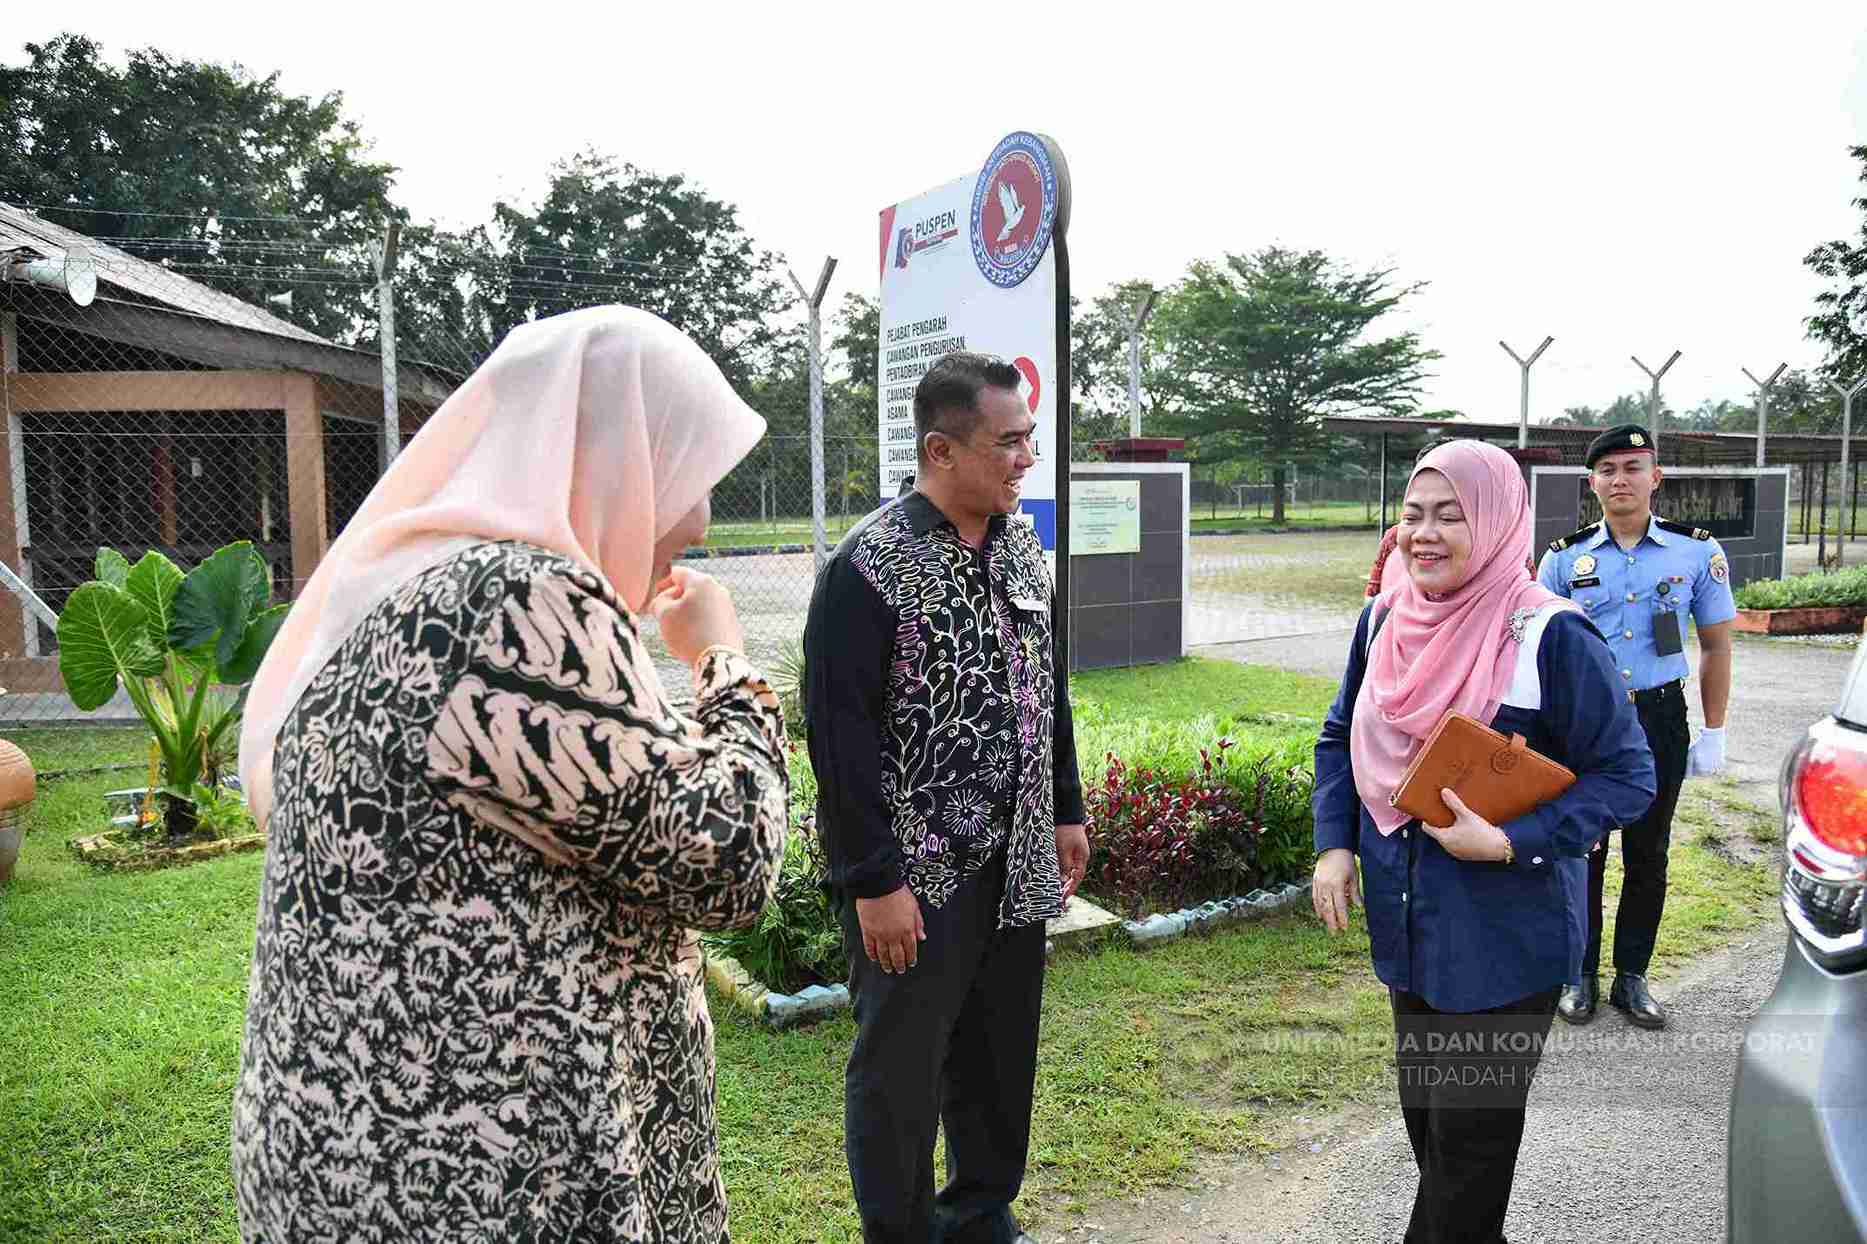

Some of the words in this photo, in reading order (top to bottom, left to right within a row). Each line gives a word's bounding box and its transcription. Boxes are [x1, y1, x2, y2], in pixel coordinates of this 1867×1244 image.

[915, 209, 956, 239] PUSPEN
[887, 324, 911, 344] PEJABAT
[912, 315, 948, 337] PENGARAH
[887, 345, 919, 364] CAWANGAN
